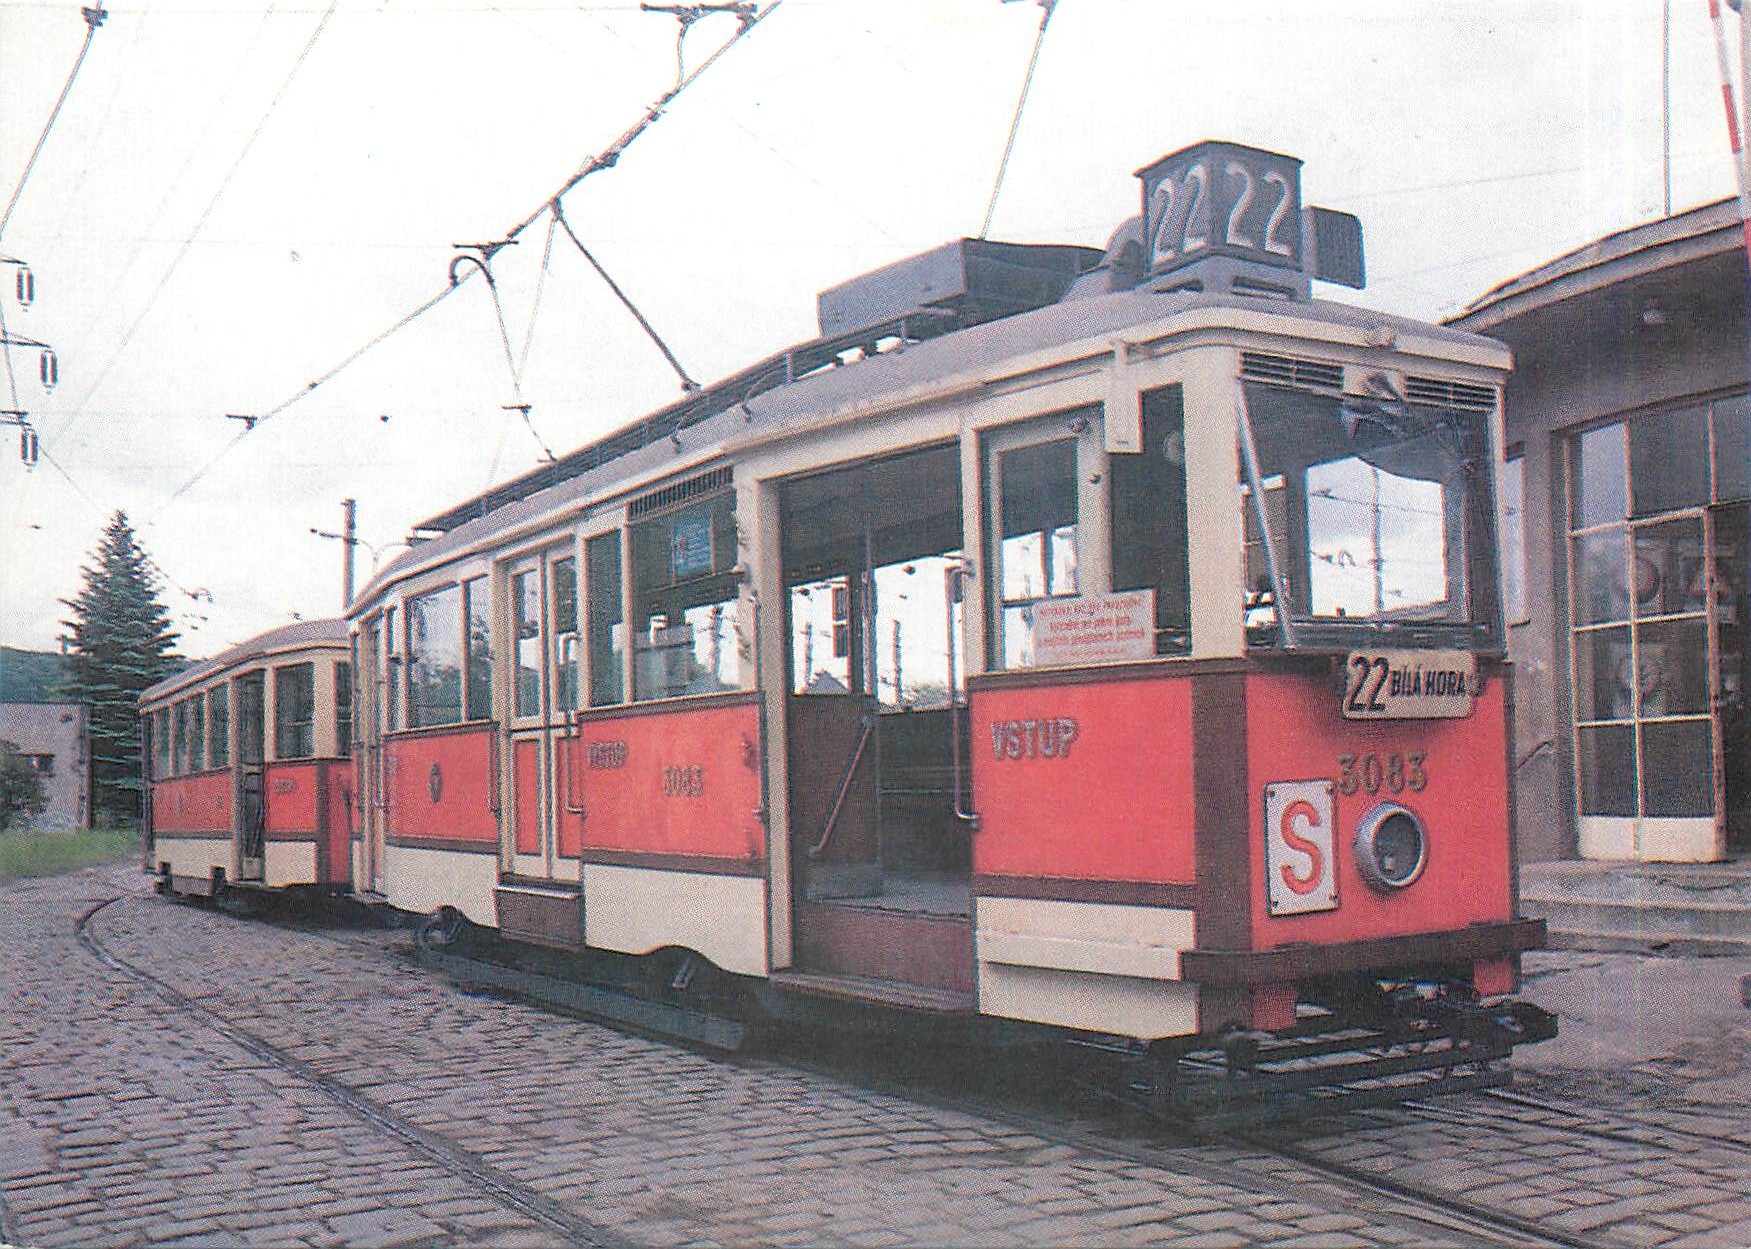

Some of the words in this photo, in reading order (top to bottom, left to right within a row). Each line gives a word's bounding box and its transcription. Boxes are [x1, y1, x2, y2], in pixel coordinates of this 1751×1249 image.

[1150, 164, 1207, 264] 22
[1223, 163, 1292, 257] 22
[1347, 656, 1389, 712] 22
[1390, 664, 1421, 697] BÍLÁ
[1424, 669, 1467, 698] HORA
[989, 716, 1078, 760] VSTUP
[1338, 752, 1427, 796] 3083
[1280, 799, 1323, 895] S
